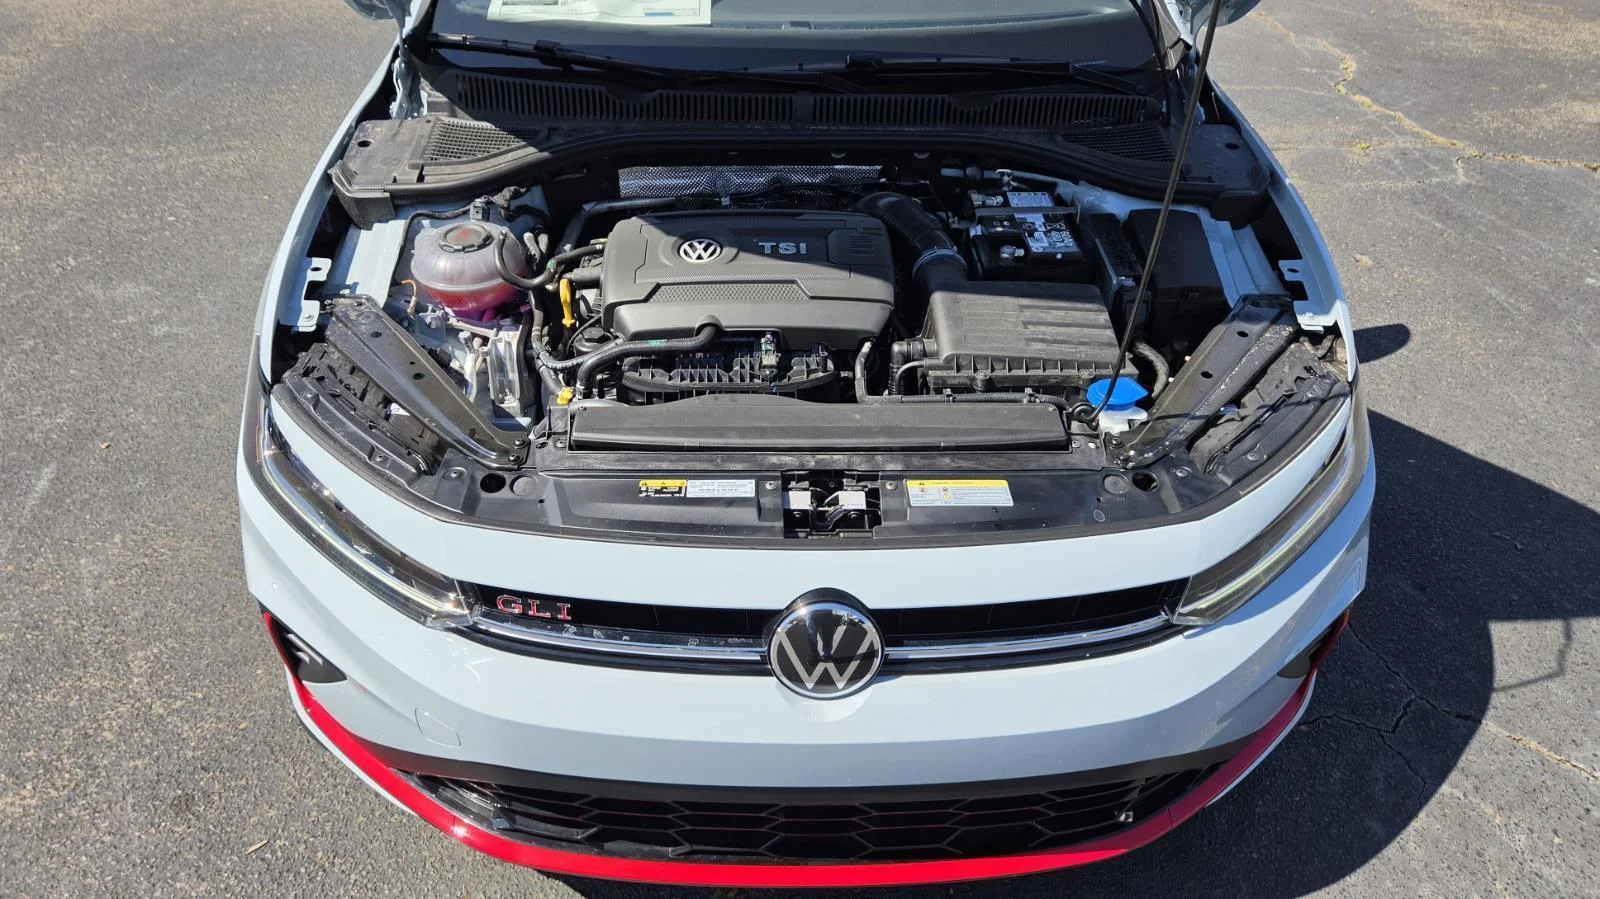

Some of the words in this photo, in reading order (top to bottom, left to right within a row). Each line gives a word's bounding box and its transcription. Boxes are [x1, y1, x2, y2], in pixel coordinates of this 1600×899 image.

[680, 239, 721, 262] VW
[758, 242, 807, 254] TSI
[496, 594, 572, 621] GLI
[772, 605, 880, 696] VW
